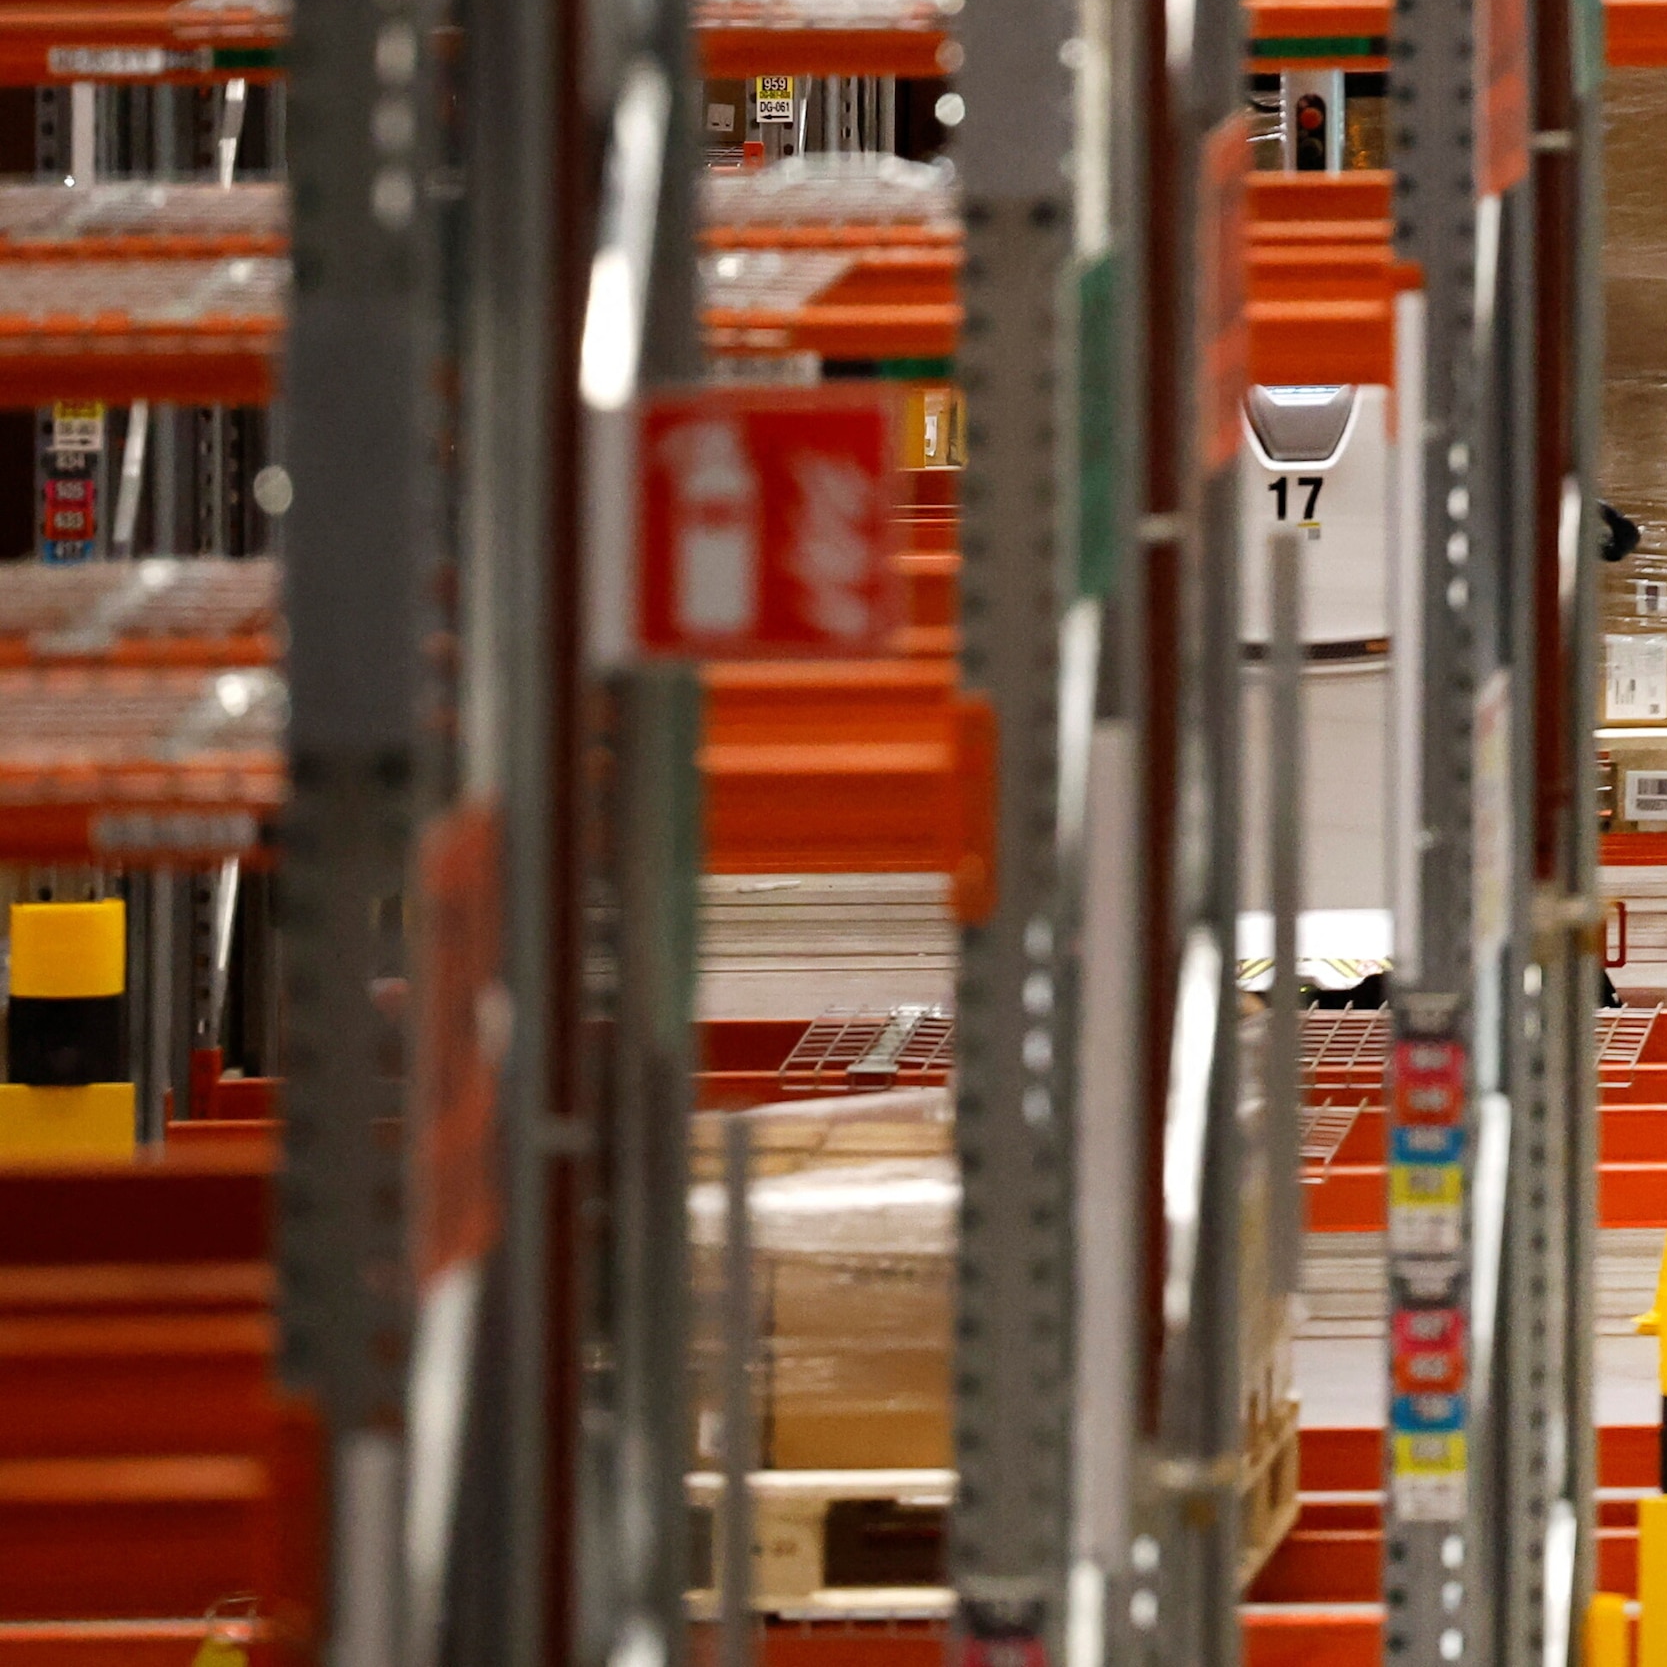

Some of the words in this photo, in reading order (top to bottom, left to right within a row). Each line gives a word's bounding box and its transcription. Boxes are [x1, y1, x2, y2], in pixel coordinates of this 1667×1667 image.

[763, 78, 786, 91] 959
[760, 101, 789, 113] DG-061
[1268, 476, 1324, 521] 17
